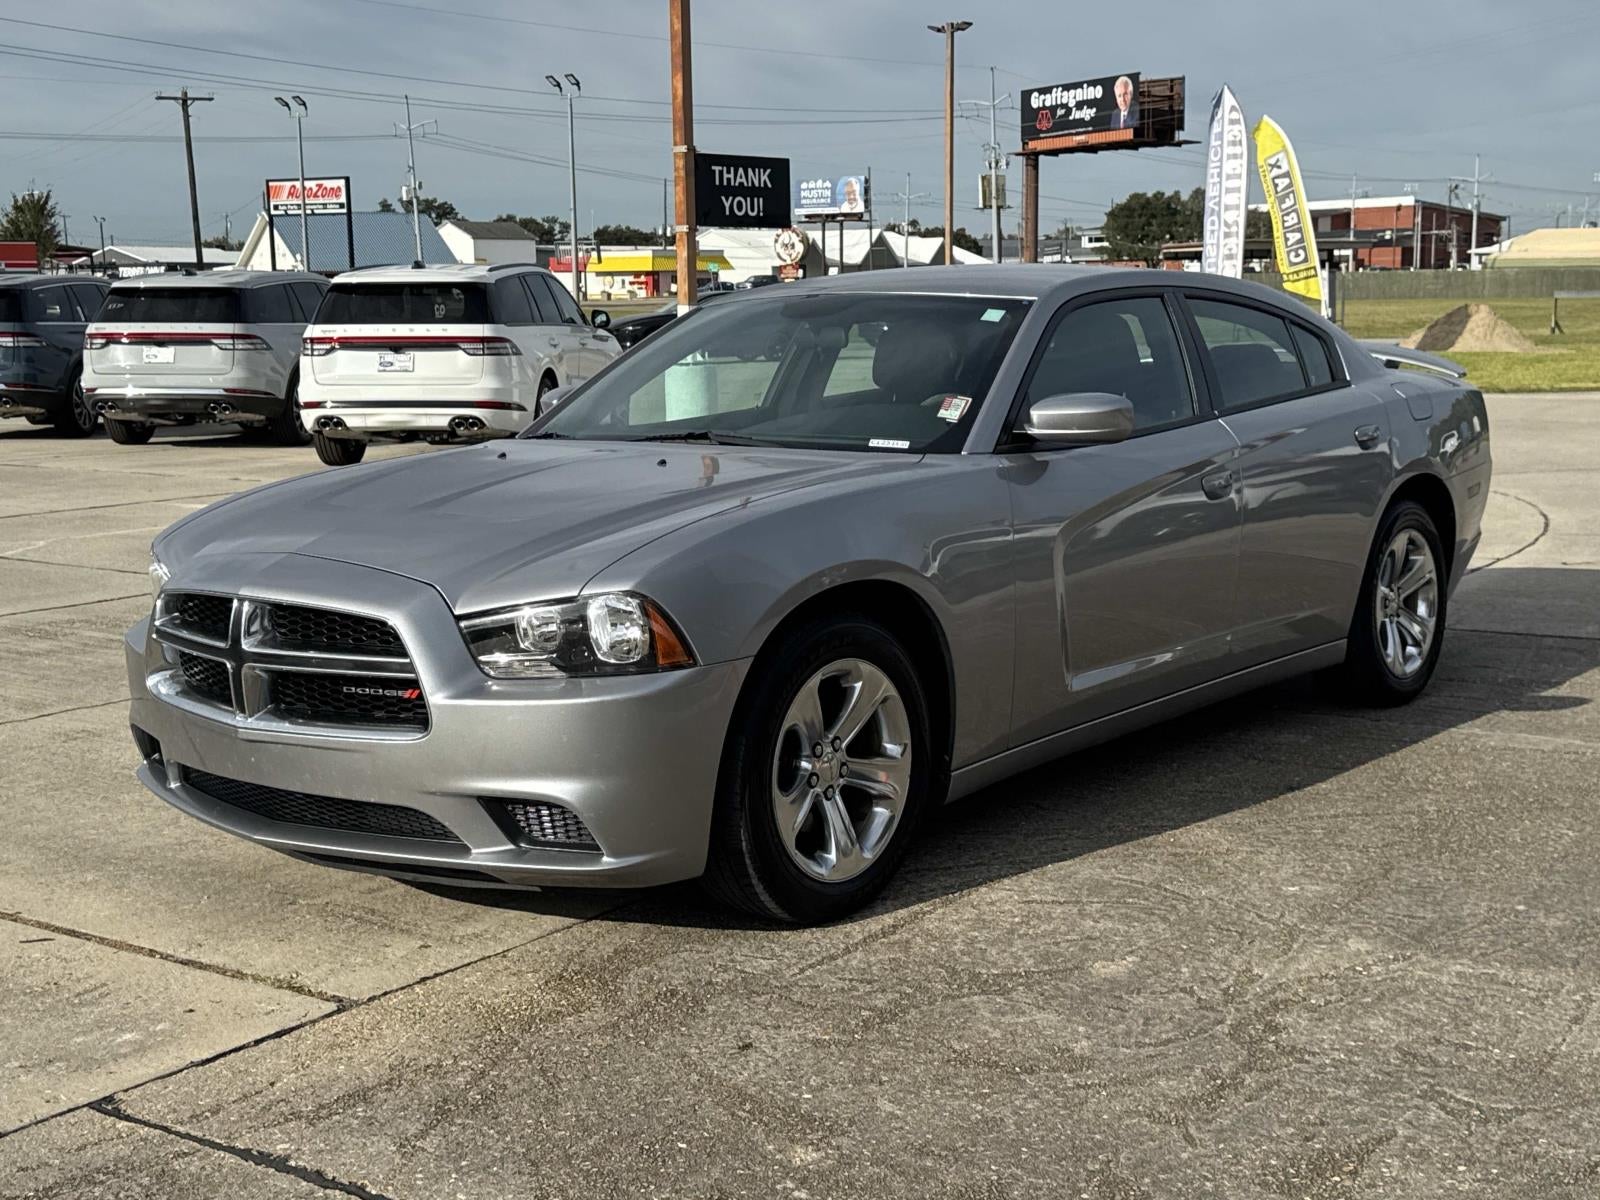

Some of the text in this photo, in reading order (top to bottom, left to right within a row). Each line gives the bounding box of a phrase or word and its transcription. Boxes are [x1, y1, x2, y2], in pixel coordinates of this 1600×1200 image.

[1030, 83, 1103, 109] Graffagnino
[1056, 105, 1097, 121] for Judge
[711, 165, 772, 188] THANK
[801, 189, 831, 199] MUSTIN
[721, 196, 764, 217] YOU!
[343, 686, 406, 698] DODGE
